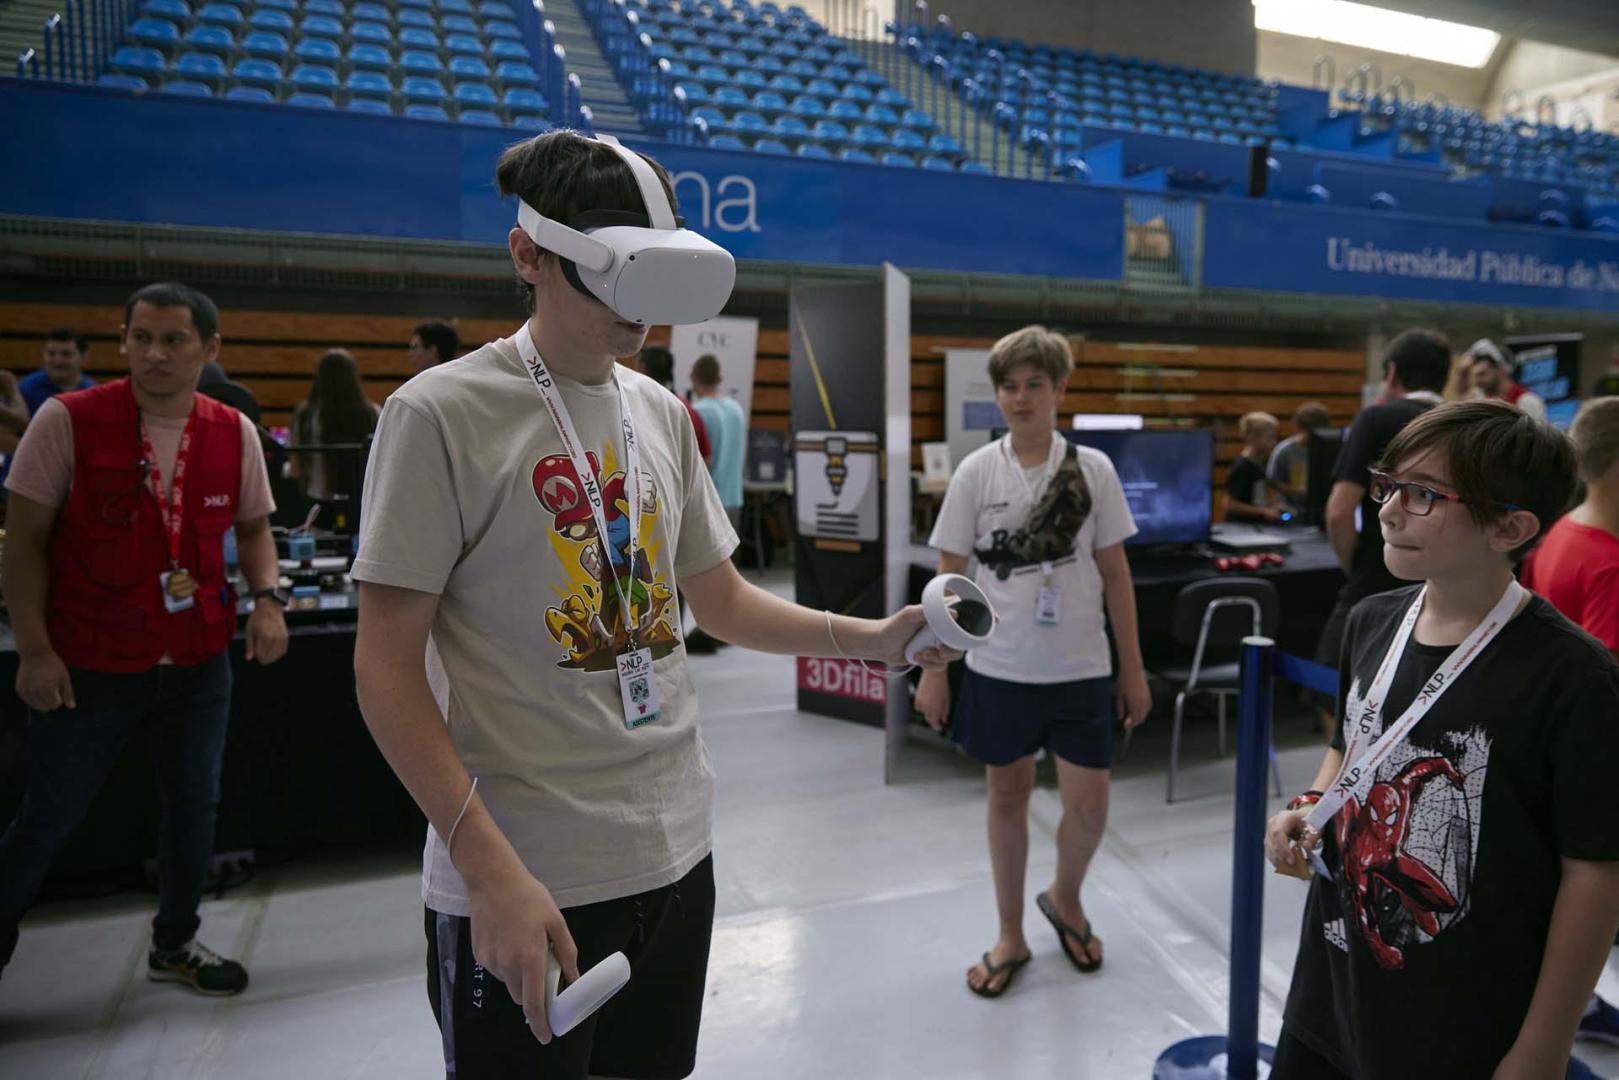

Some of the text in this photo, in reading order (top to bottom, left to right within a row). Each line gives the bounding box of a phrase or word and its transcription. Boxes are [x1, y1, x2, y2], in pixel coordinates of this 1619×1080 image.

[1327, 236, 1475, 281] Universidad
[1480, 249, 1565, 288] Pública
[1567, 258, 1596, 290] de
[472, 988, 483, 1009] 97
